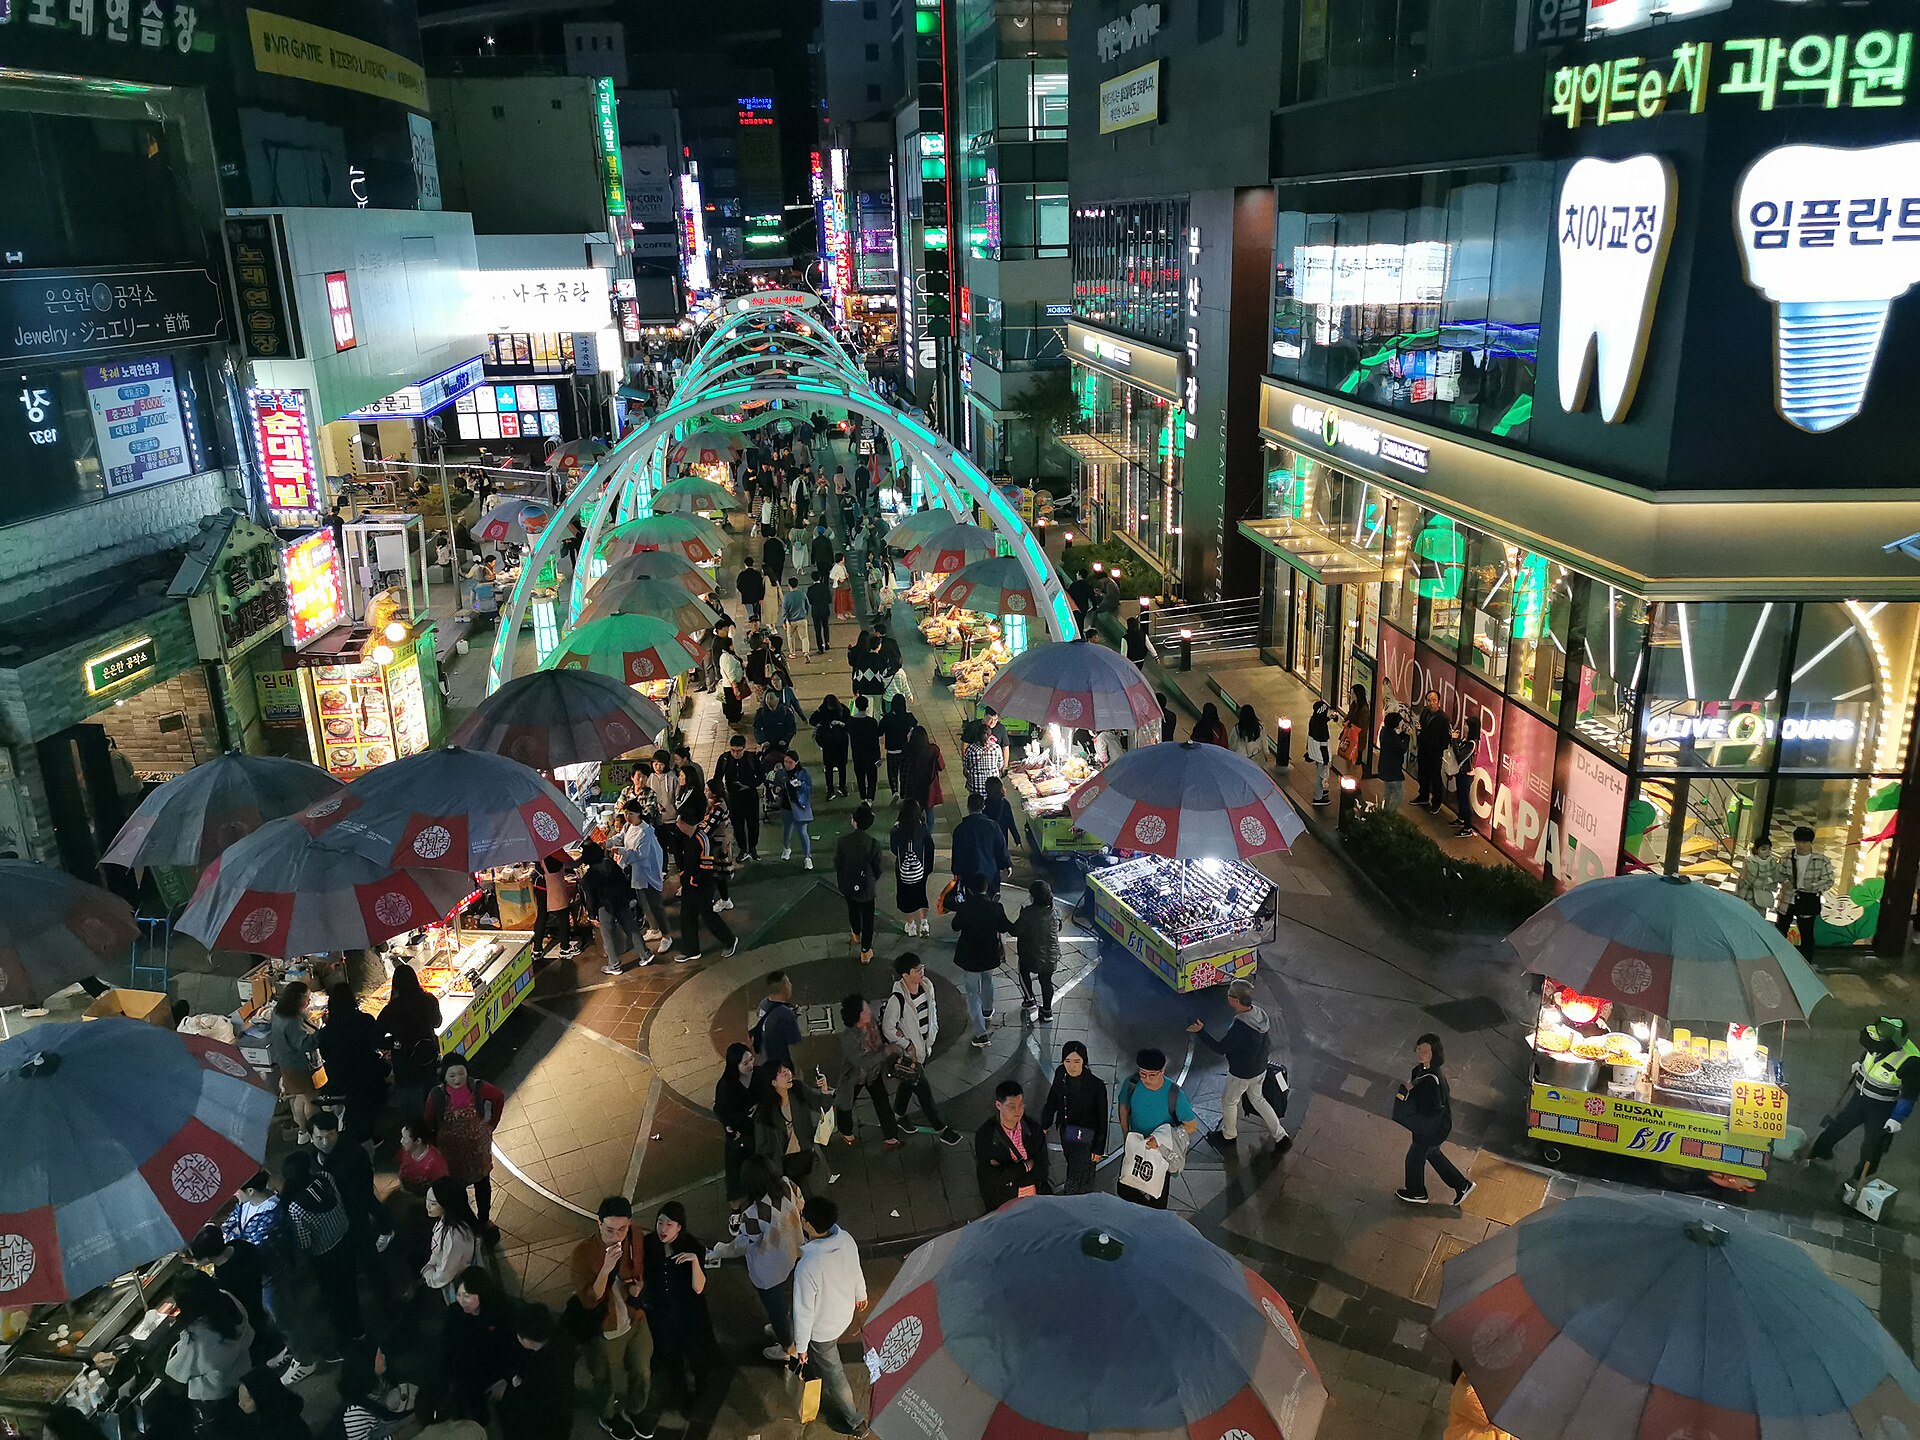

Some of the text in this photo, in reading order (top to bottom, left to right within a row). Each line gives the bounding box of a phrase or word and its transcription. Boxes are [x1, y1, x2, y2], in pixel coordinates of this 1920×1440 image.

[1561, 204, 1657, 254] 치아교정
[44, 284, 157, 313] 은은한 공작소
[15, 325, 68, 346] Jewelry
[122, 362, 160, 378] 노래연습장
[258, 394, 299, 411] 옥천
[262, 412, 310, 506] 순대국밥
[1218, 409, 1227, 487] PUSAN
[1382, 439, 1427, 467] GWANGBOK
[102, 653, 148, 679] 은은한 공작소
[1647, 717, 1727, 740] OLIVE
[1577, 753, 1623, 796] Dr.Jart+
[1735, 1085, 1784, 1109] 약단밤
[1614, 1102, 1663, 1119] BUSAN
[1613, 1112, 1721, 1136] International Film Festival
[1131, 1154, 1154, 1182] 10
[901, 1392, 938, 1429] International
[919, 1399, 945, 1426] BUSAN
[910, 1412, 932, 1437] October
